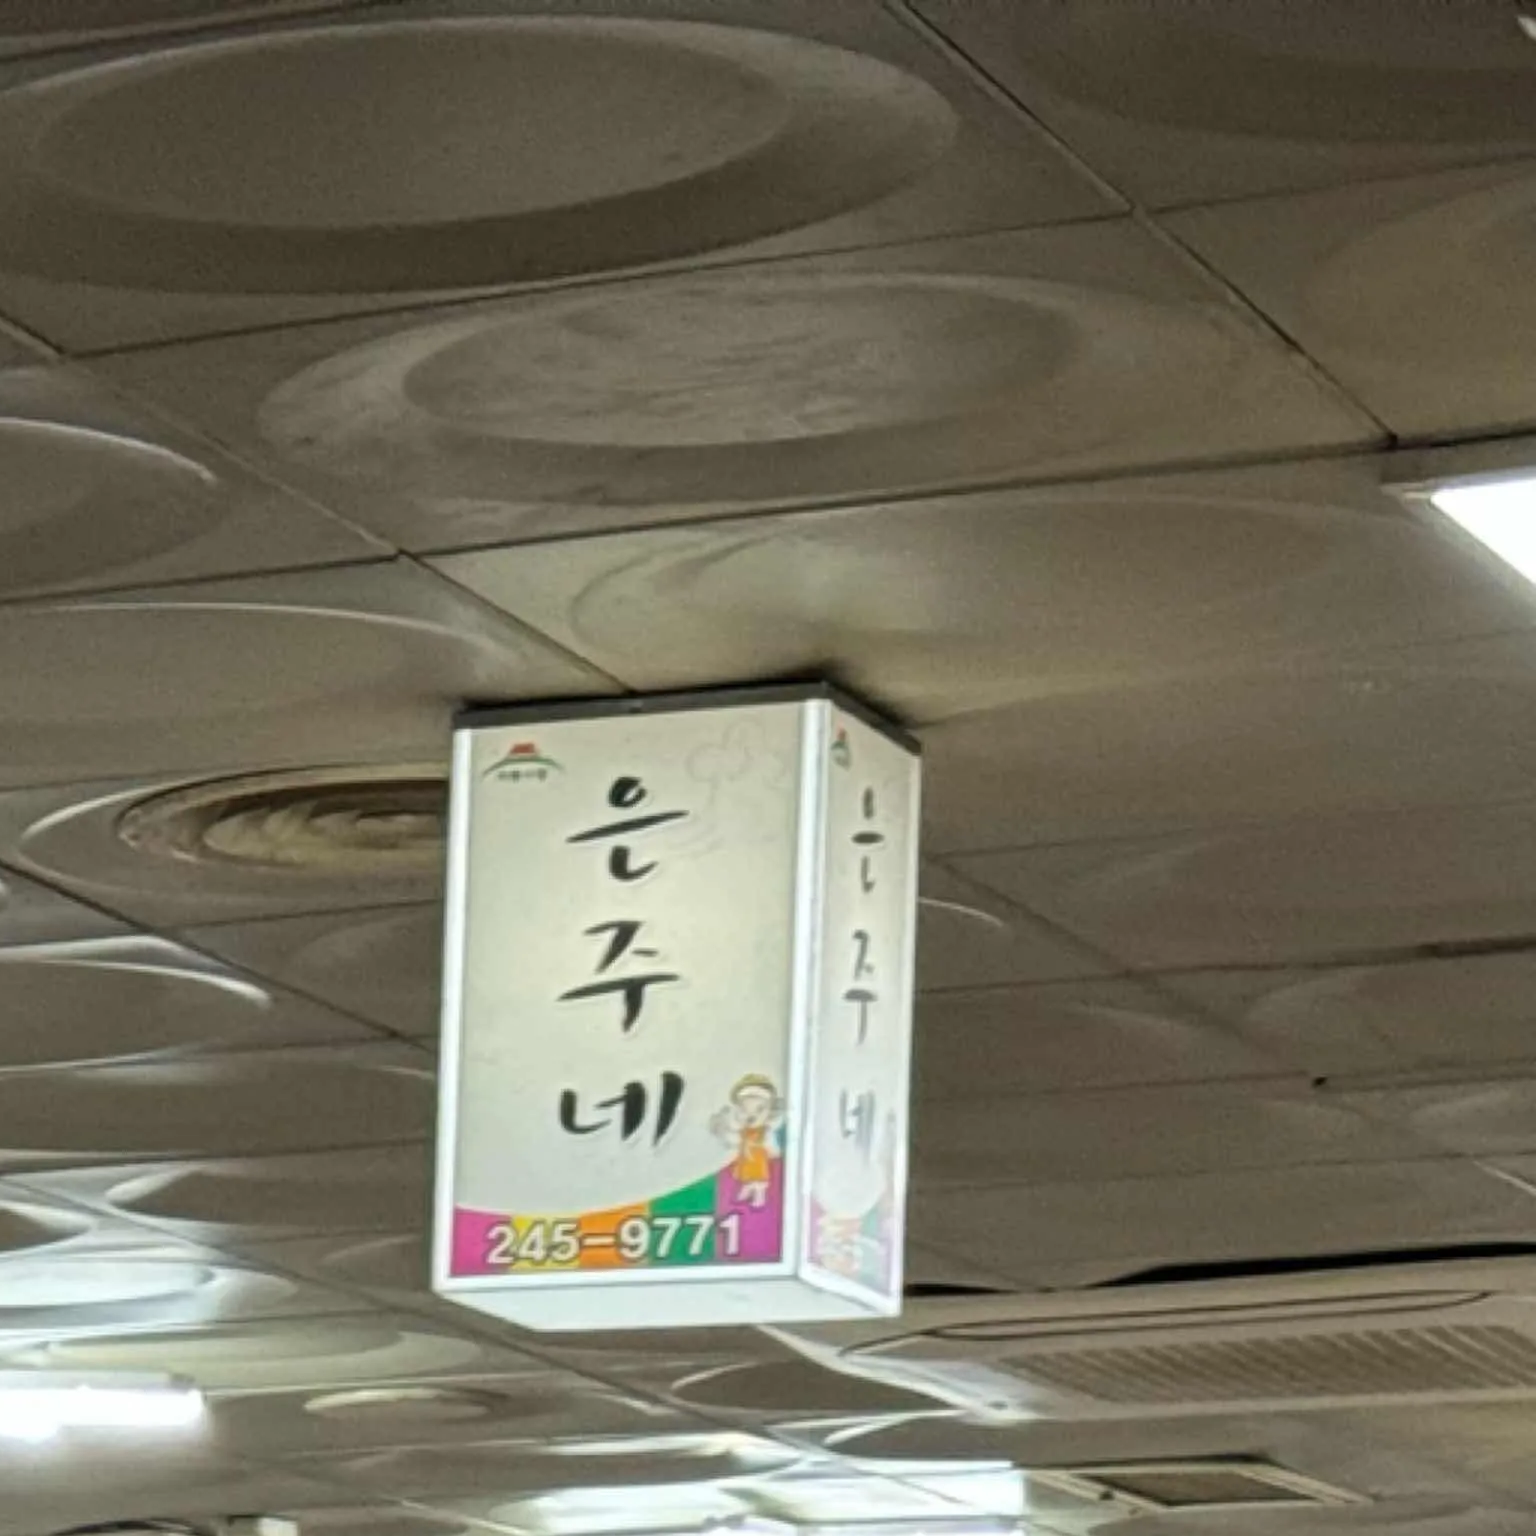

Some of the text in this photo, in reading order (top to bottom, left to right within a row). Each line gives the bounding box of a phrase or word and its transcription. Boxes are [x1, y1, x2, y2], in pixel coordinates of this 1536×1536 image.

[555, 776, 690, 1146] 은주네
[840, 787, 885, 1156] 은주네
[486, 1213, 742, 1264] 245-9771
